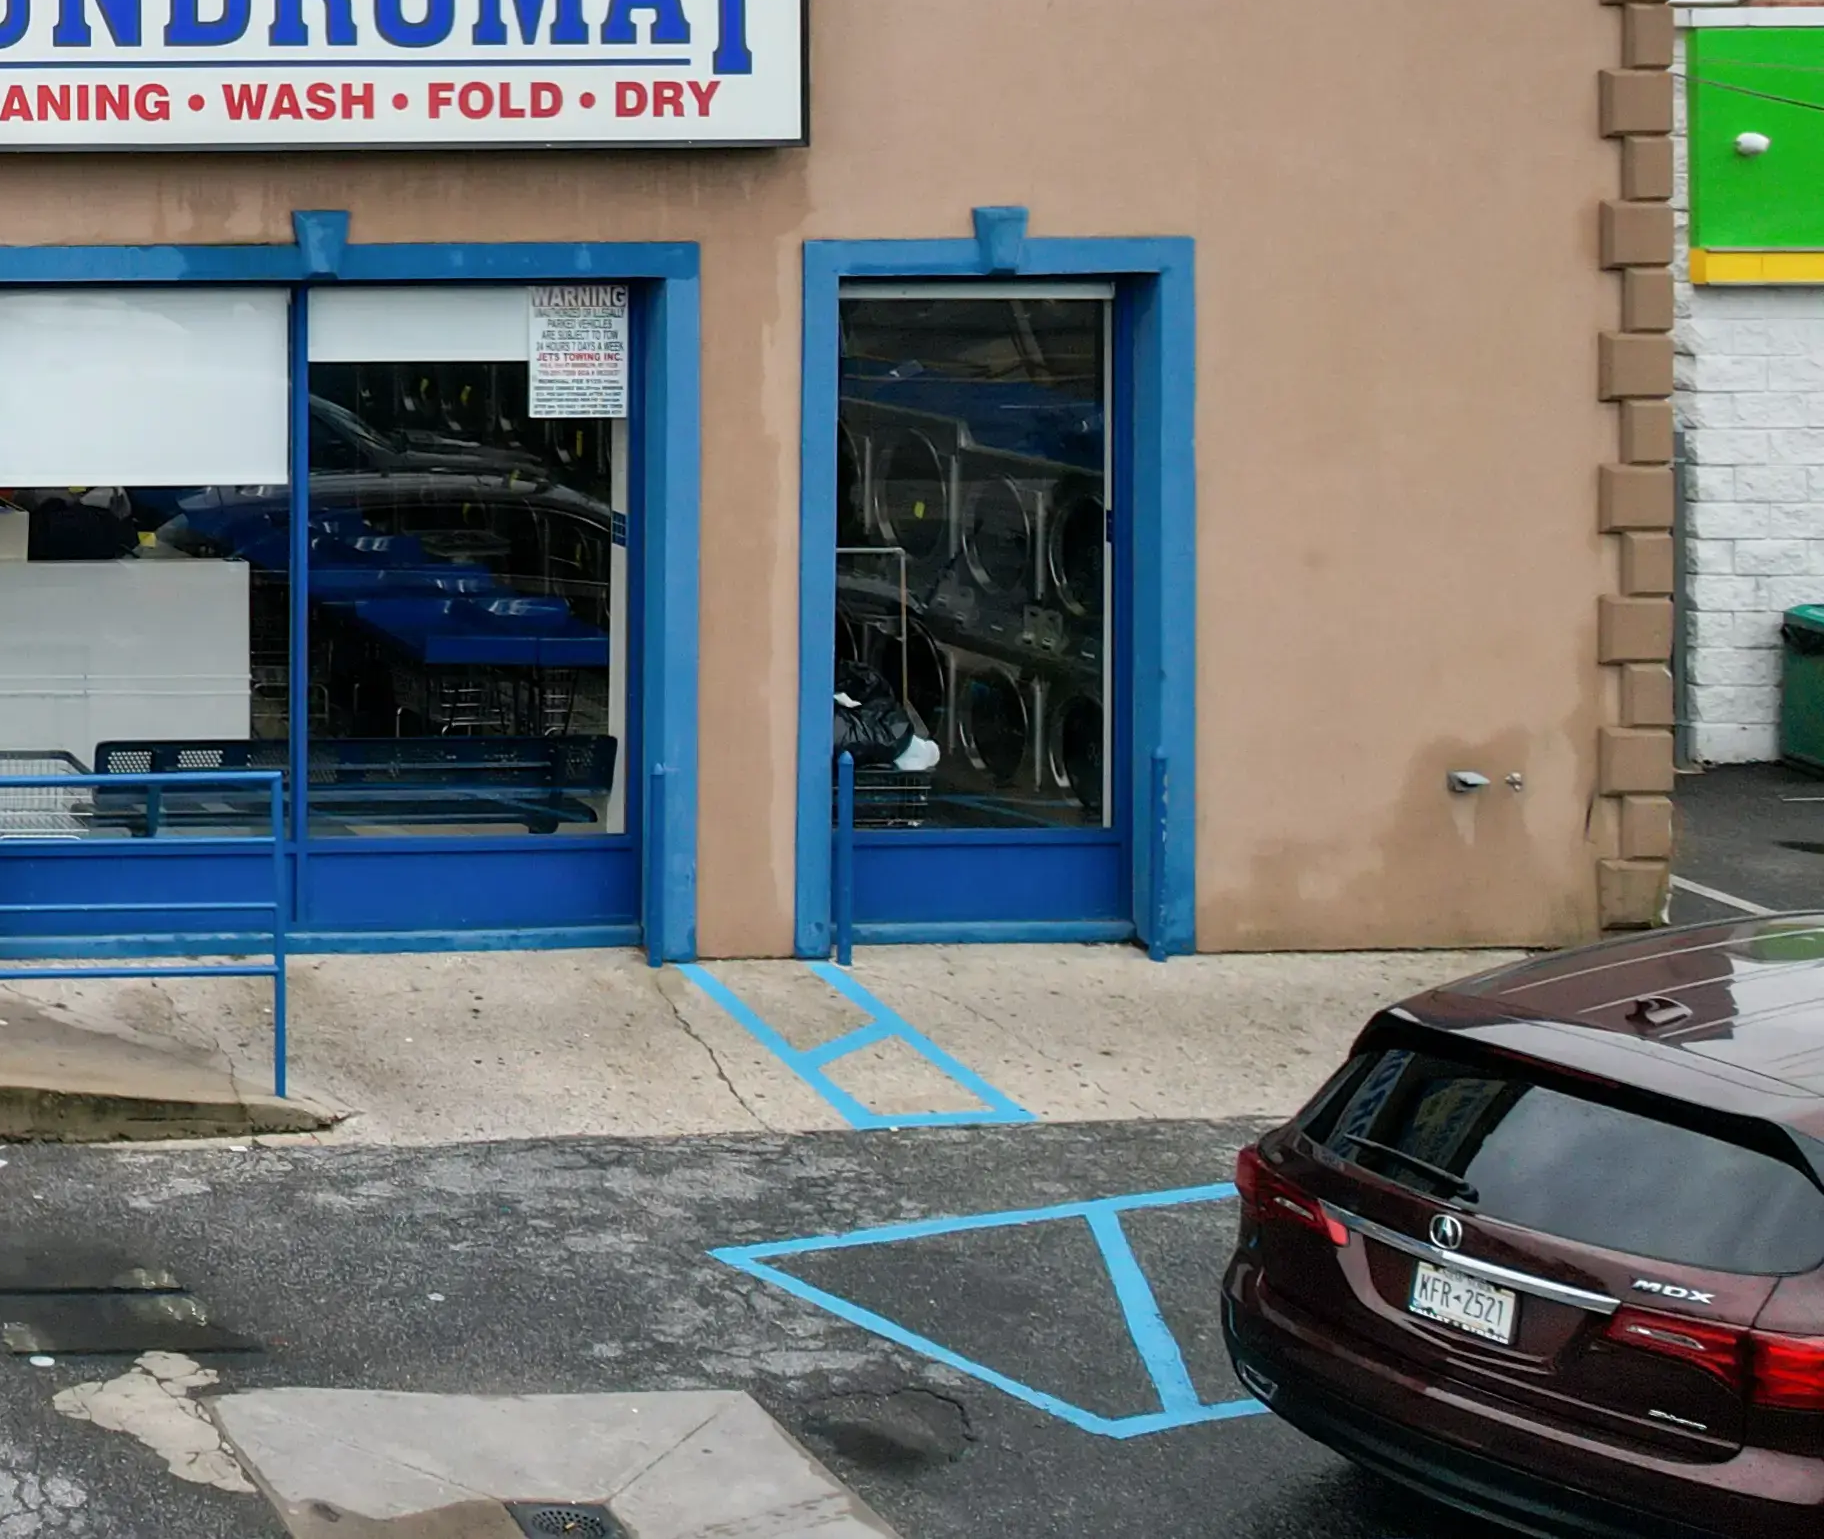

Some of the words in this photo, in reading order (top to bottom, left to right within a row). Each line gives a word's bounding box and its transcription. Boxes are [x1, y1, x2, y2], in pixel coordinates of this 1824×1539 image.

[221, 82, 375, 120] WASH
[427, 81, 563, 120] FOLD
[613, 80, 722, 119] DRY
[532, 286, 626, 307] WARNING
[1418, 1273, 1452, 1309] KFR
[1462, 1289, 1504, 1327] 2521
[1631, 1279, 1716, 1305] MDX
